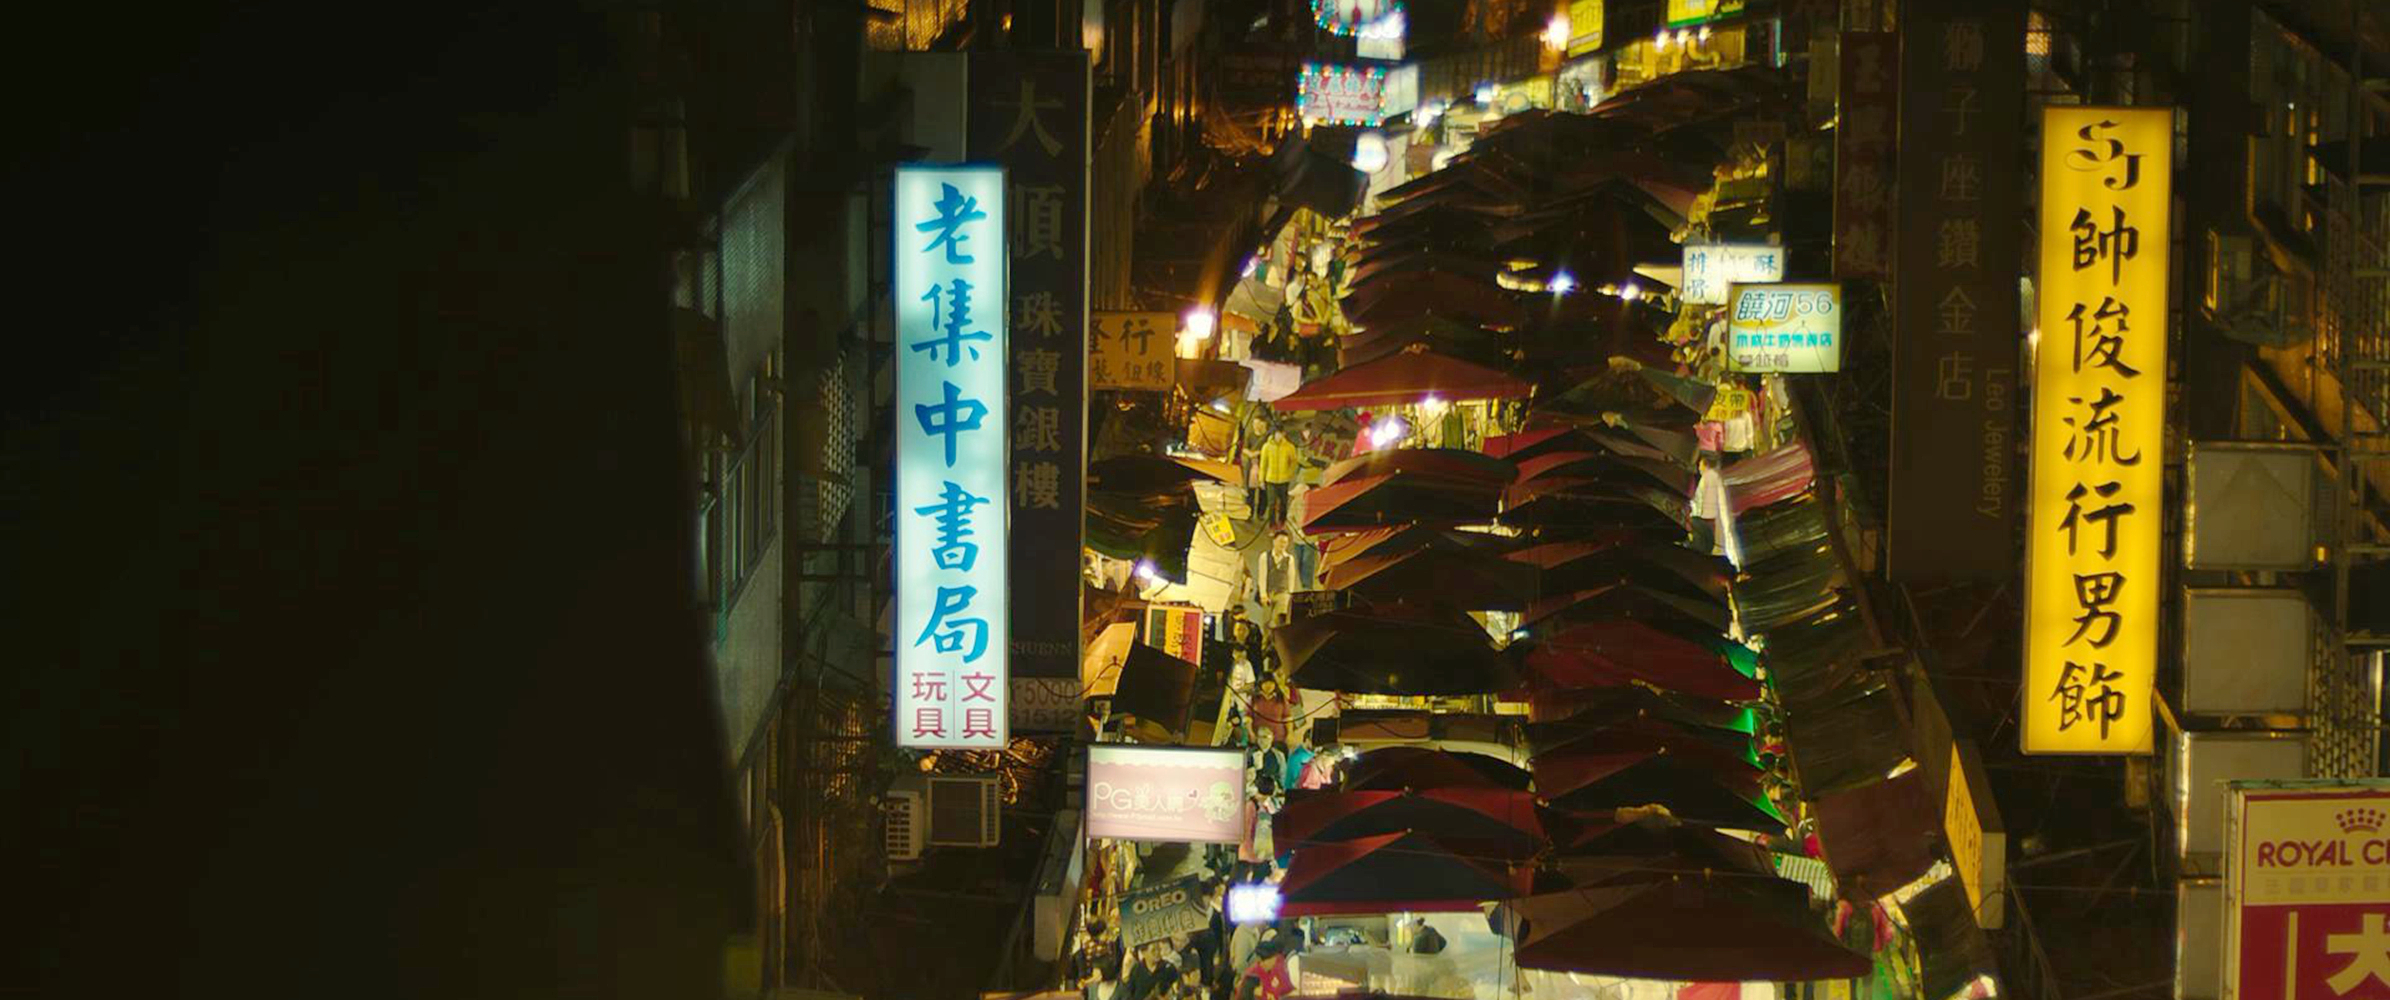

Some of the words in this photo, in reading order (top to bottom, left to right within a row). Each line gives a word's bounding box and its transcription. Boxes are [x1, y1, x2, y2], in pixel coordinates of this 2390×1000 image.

[911, 182, 993, 664] 老集中書局
[2049, 204, 2142, 741] 帥俊流行男飾
[912, 672, 947, 740] 玩具
[961, 671, 996, 740] 文具
[2258, 840, 2353, 867] ROYAL
[2363, 839, 2390, 866] C
[1133, 890, 1187, 915] OREO
